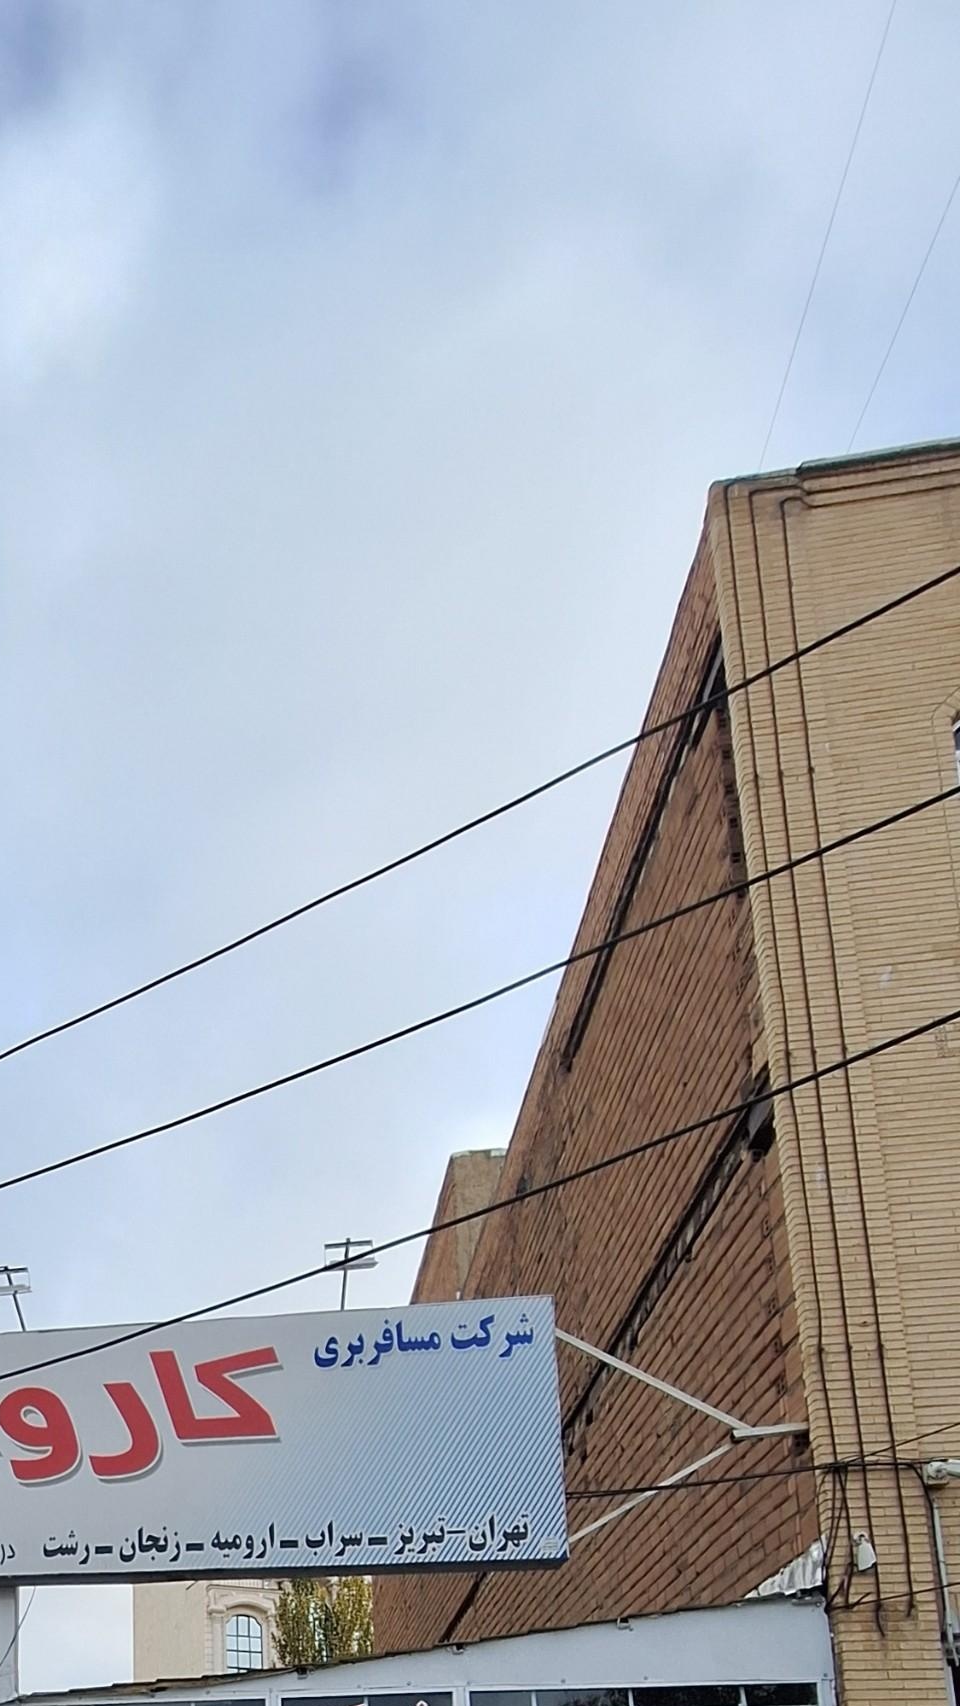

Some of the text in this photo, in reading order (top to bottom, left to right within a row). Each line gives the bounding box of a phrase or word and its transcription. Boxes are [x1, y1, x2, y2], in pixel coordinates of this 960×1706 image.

[314, 1313, 535, 1368] شرکت مسافربری
[43, 1530, 90, 1565] رشت
[119, 1526, 180, 1562] زنجان
[211, 1522, 274, 1560] ارومیه
[305, 1520, 363, 1557] سراب
